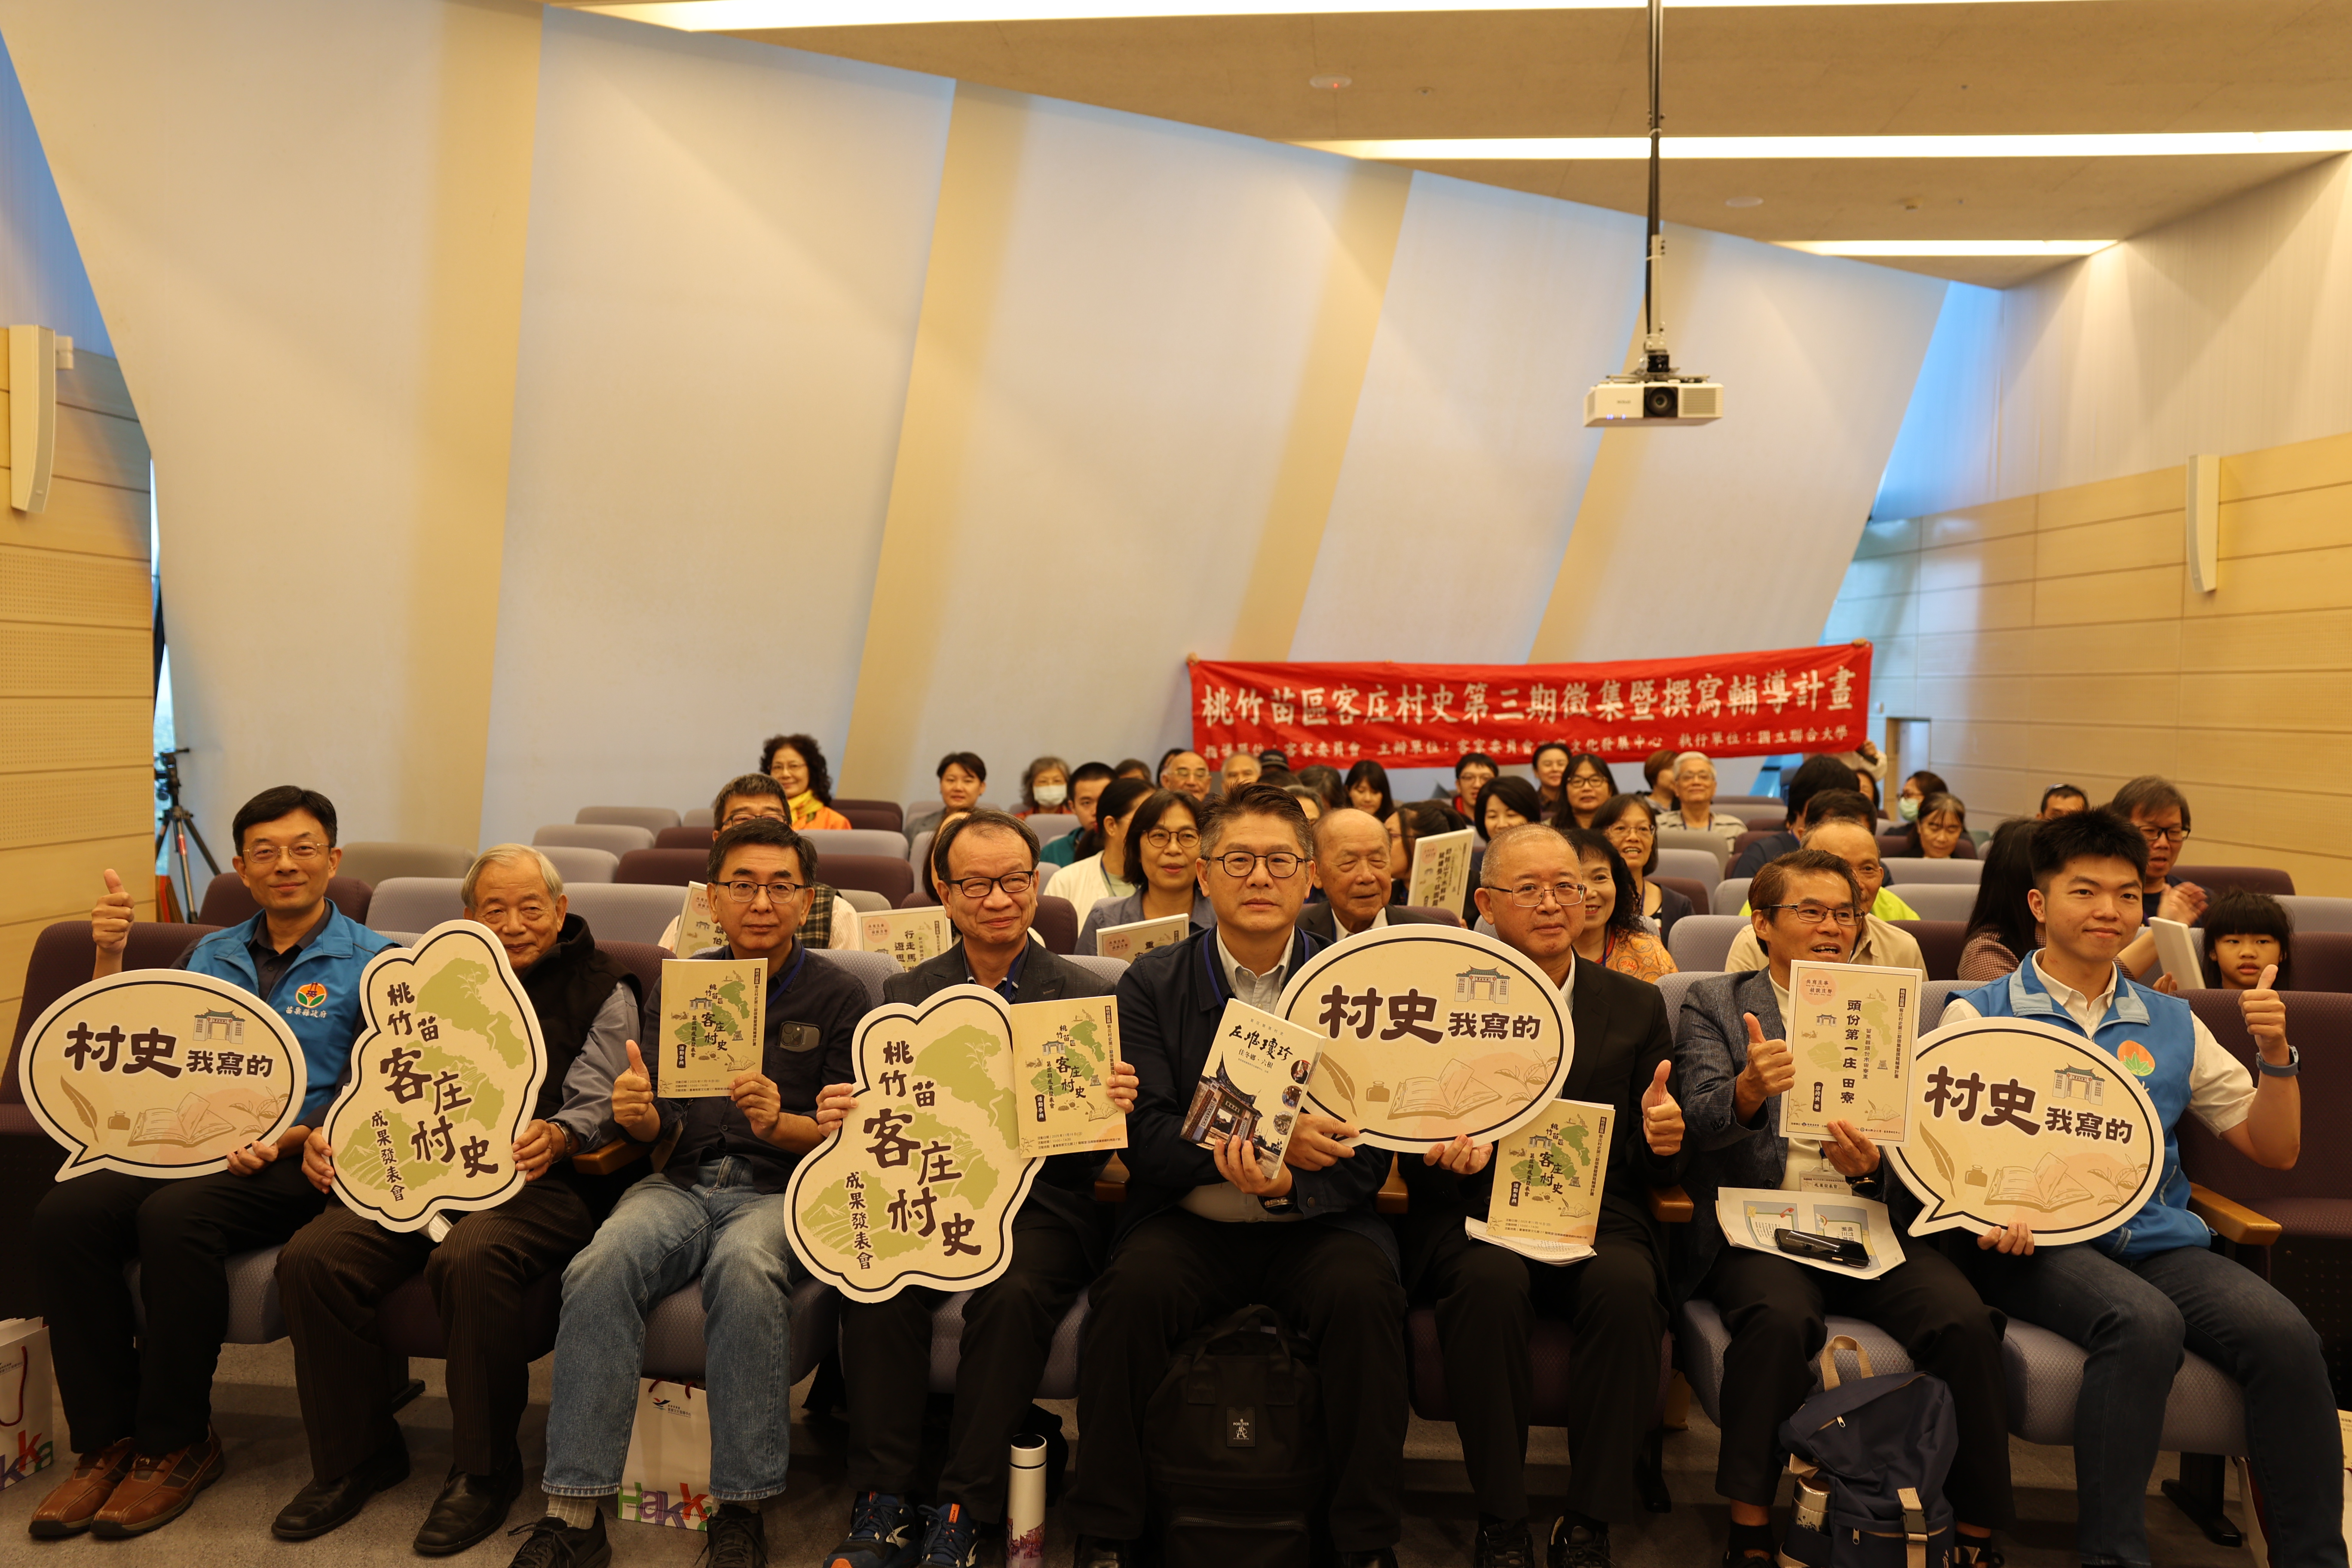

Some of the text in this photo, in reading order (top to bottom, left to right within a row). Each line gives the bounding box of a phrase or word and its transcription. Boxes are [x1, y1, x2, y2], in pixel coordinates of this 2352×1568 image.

[387, 981, 439, 1041] 桃竹苗
[701, 1012, 728, 1051] 客庄村史
[1319, 984, 1541, 1042] 村史 我寫的
[1843, 1000, 1862, 1069] 頭份第一庄
[64, 1021, 273, 1078] 村史 我寫的
[879, 1040, 937, 1108] 桃竹苗
[1056, 1057, 1086, 1098] 客庄村史
[379, 1047, 499, 1179] 客庄村史
[1924, 1065, 2133, 1144] 村史 我寫的
[371, 1111, 404, 1202] 成果發表會
[863, 1109, 982, 1257] 客庄村史
[1539, 1152, 1563, 1195] 客庄村史
[845, 1171, 873, 1270] 成果發表會
